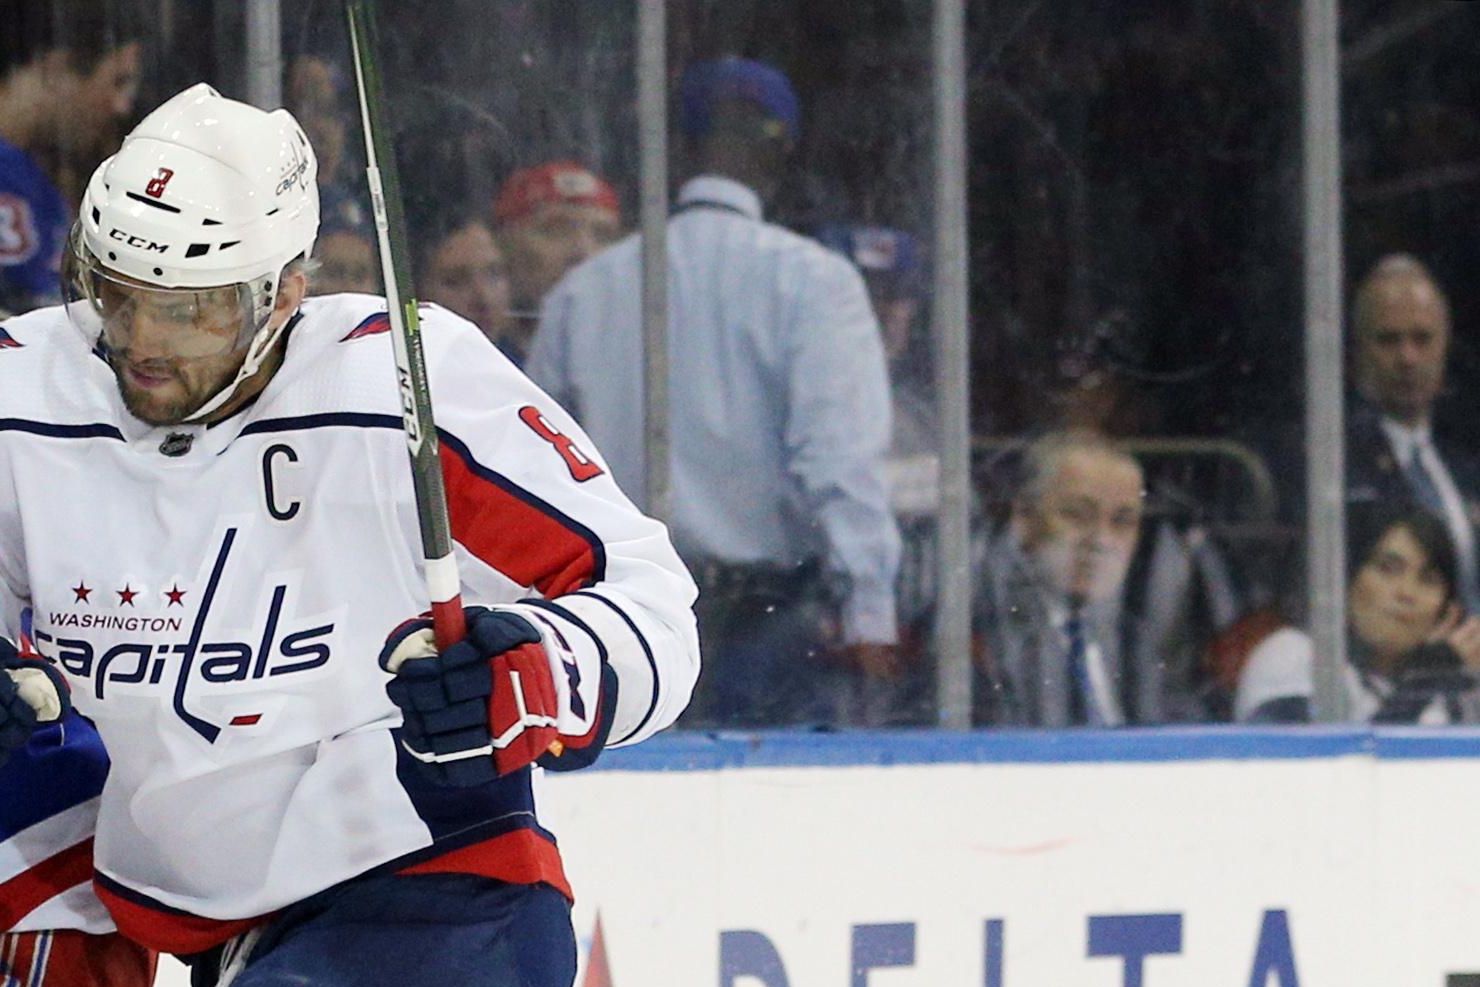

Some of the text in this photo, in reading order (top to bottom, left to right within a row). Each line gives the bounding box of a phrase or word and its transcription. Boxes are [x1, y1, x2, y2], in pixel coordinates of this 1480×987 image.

[109, 228, 170, 255] CCM
[397, 366, 418, 442] CCM
[263, 443, 300, 521] C
[518, 405, 605, 483] 8
[34, 528, 335, 744] capitals
[49, 612, 183, 633] WASHINGTON
